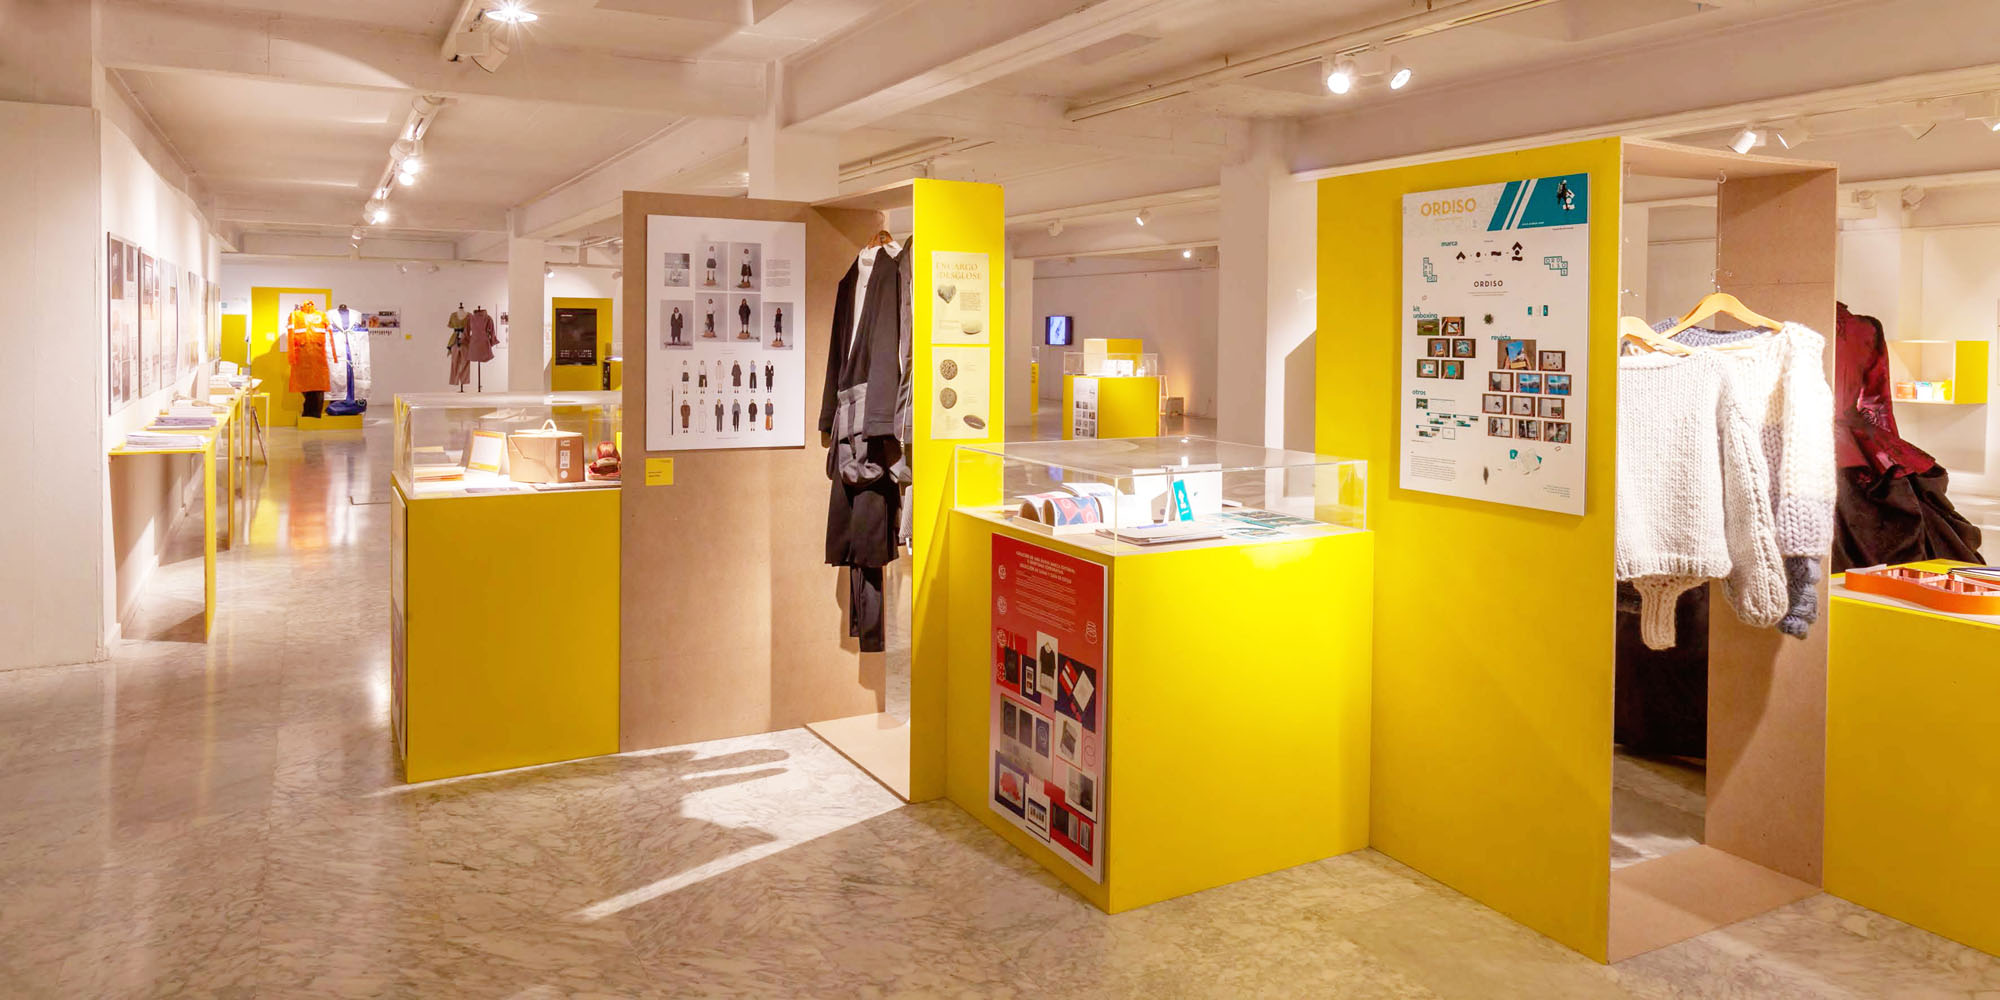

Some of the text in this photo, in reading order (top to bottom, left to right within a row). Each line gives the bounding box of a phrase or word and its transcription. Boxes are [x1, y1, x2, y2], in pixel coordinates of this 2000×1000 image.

[1421, 198, 1477, 216] ORDISO
[1474, 280, 1504, 288] ORDISO
[1413, 312, 1438, 320] unboxing
